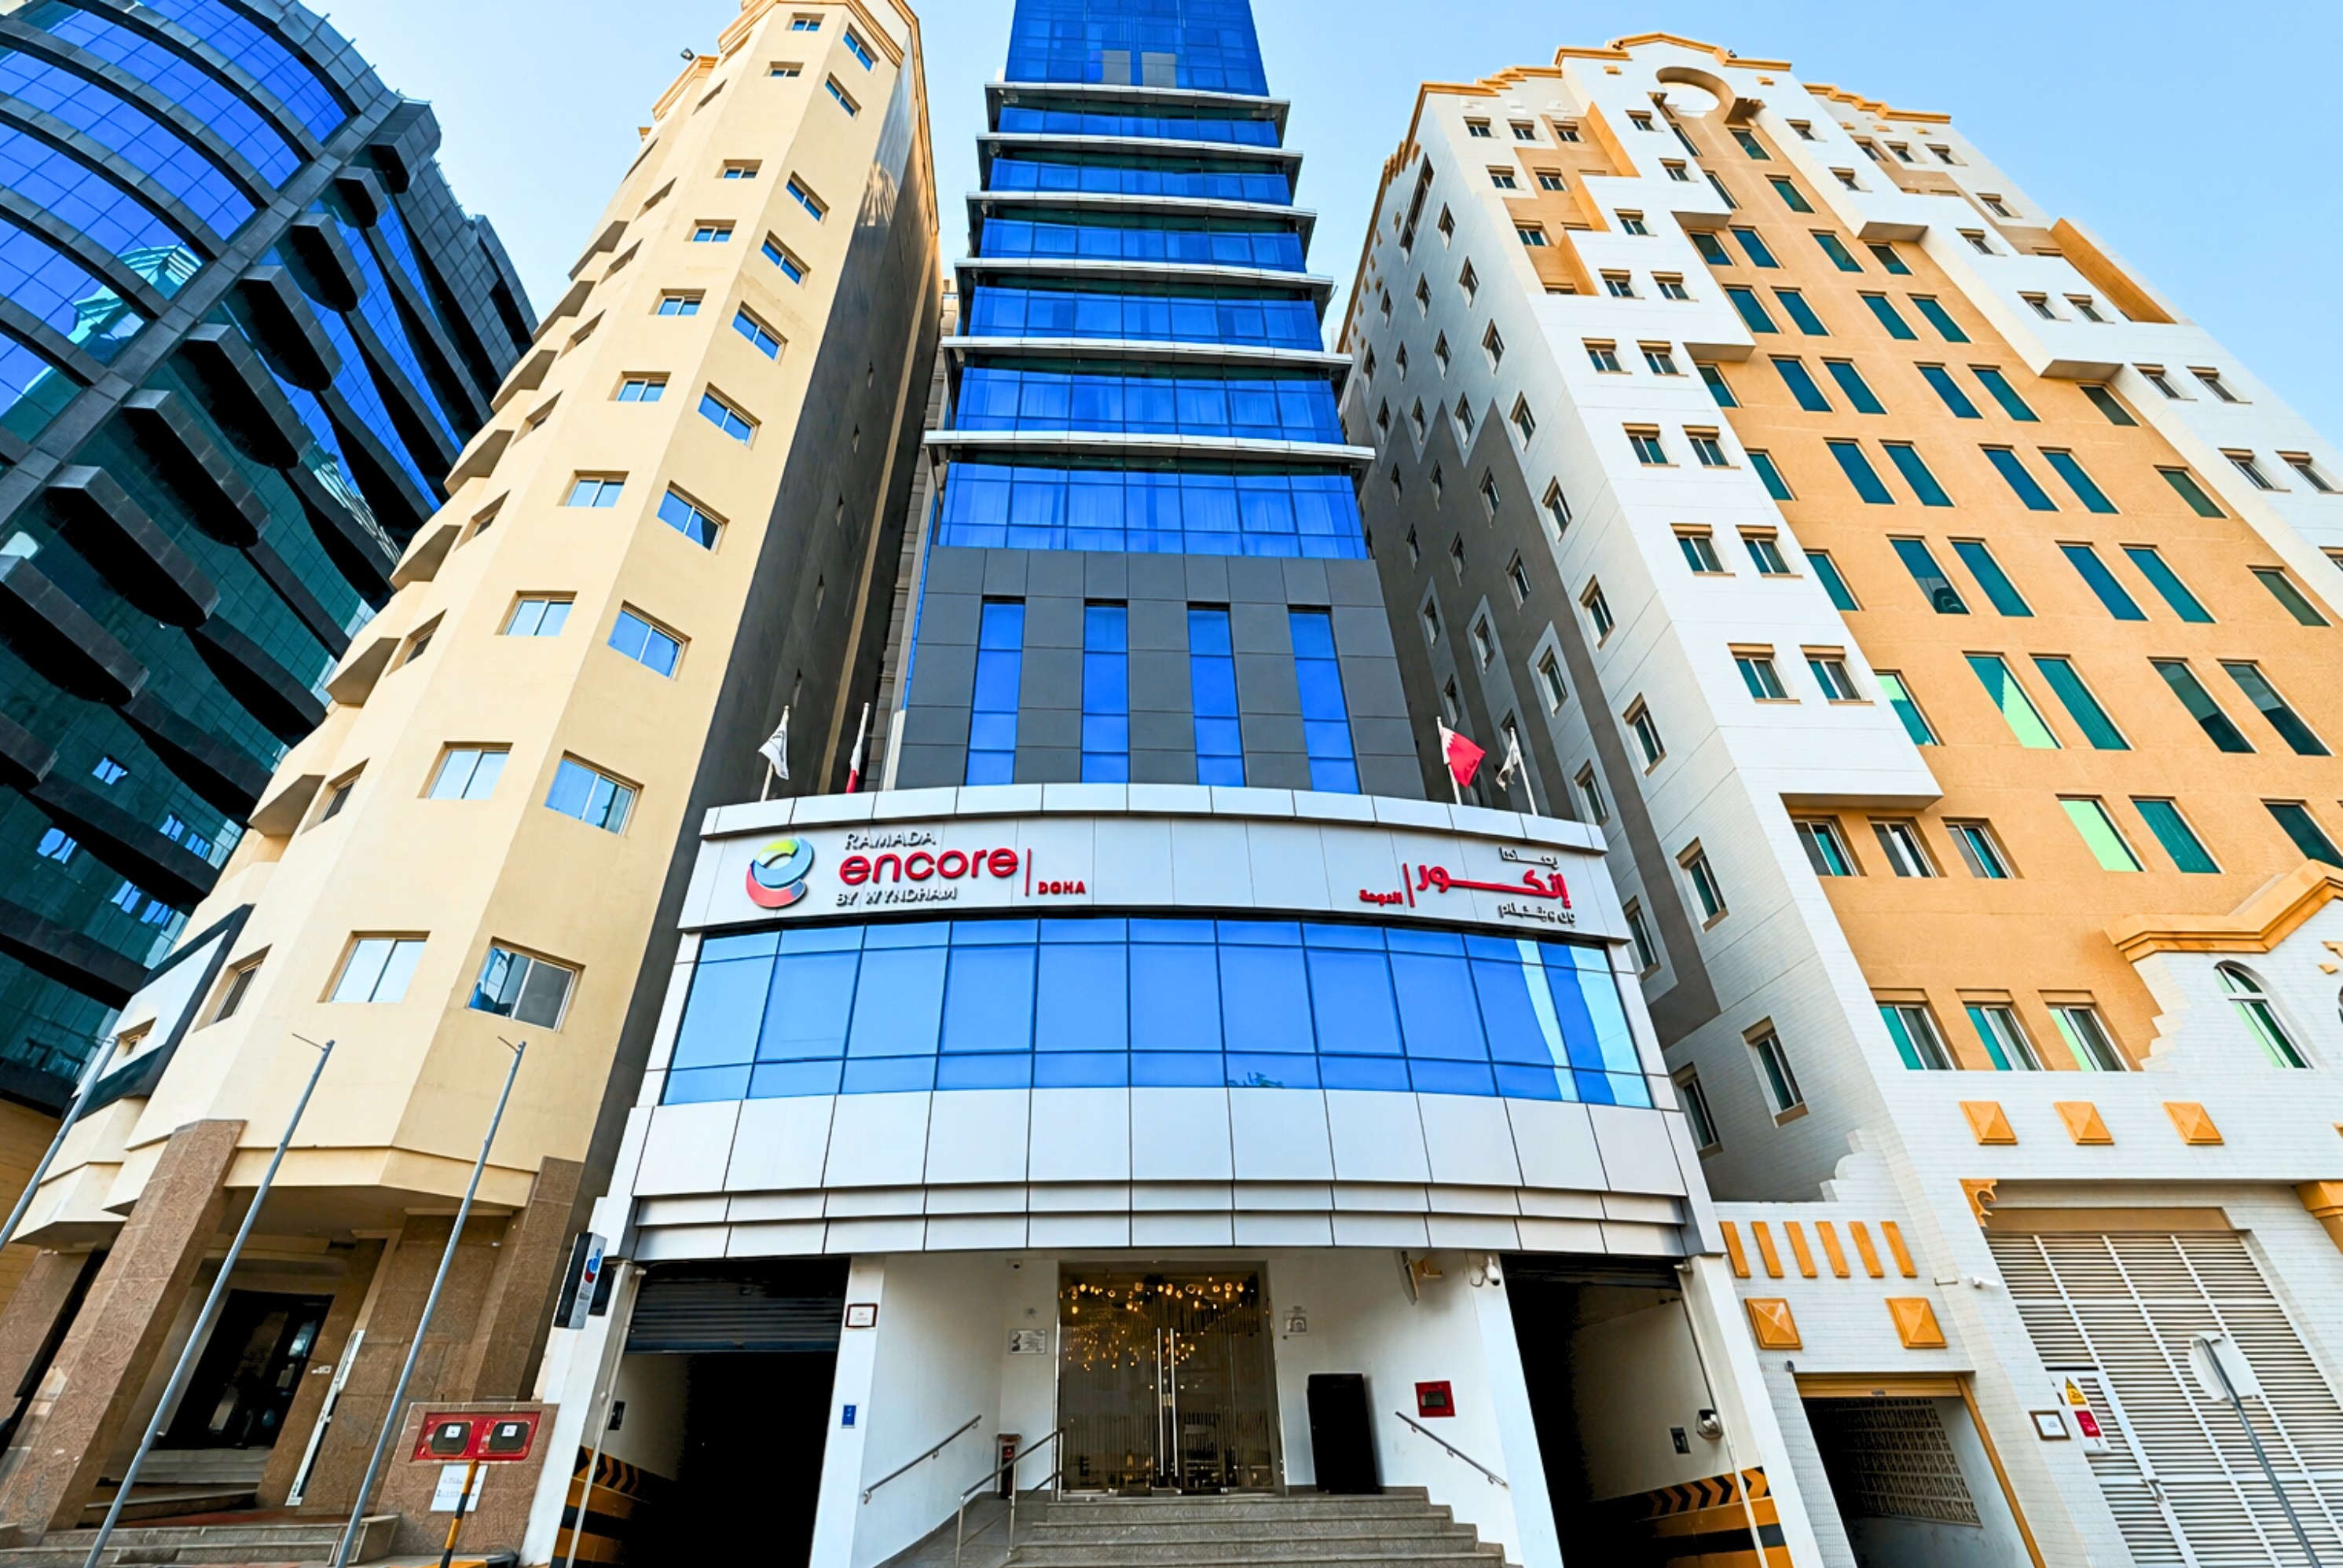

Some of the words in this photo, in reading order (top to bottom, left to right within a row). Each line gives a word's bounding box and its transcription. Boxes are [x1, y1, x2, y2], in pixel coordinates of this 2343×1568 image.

[845, 831, 937, 850] RAMADA
[839, 847, 1019, 885] encore
[835, 891, 859, 907] BY
[865, 886, 959, 905] WYNDHAM
[1037, 880, 1087, 896] DOHA
